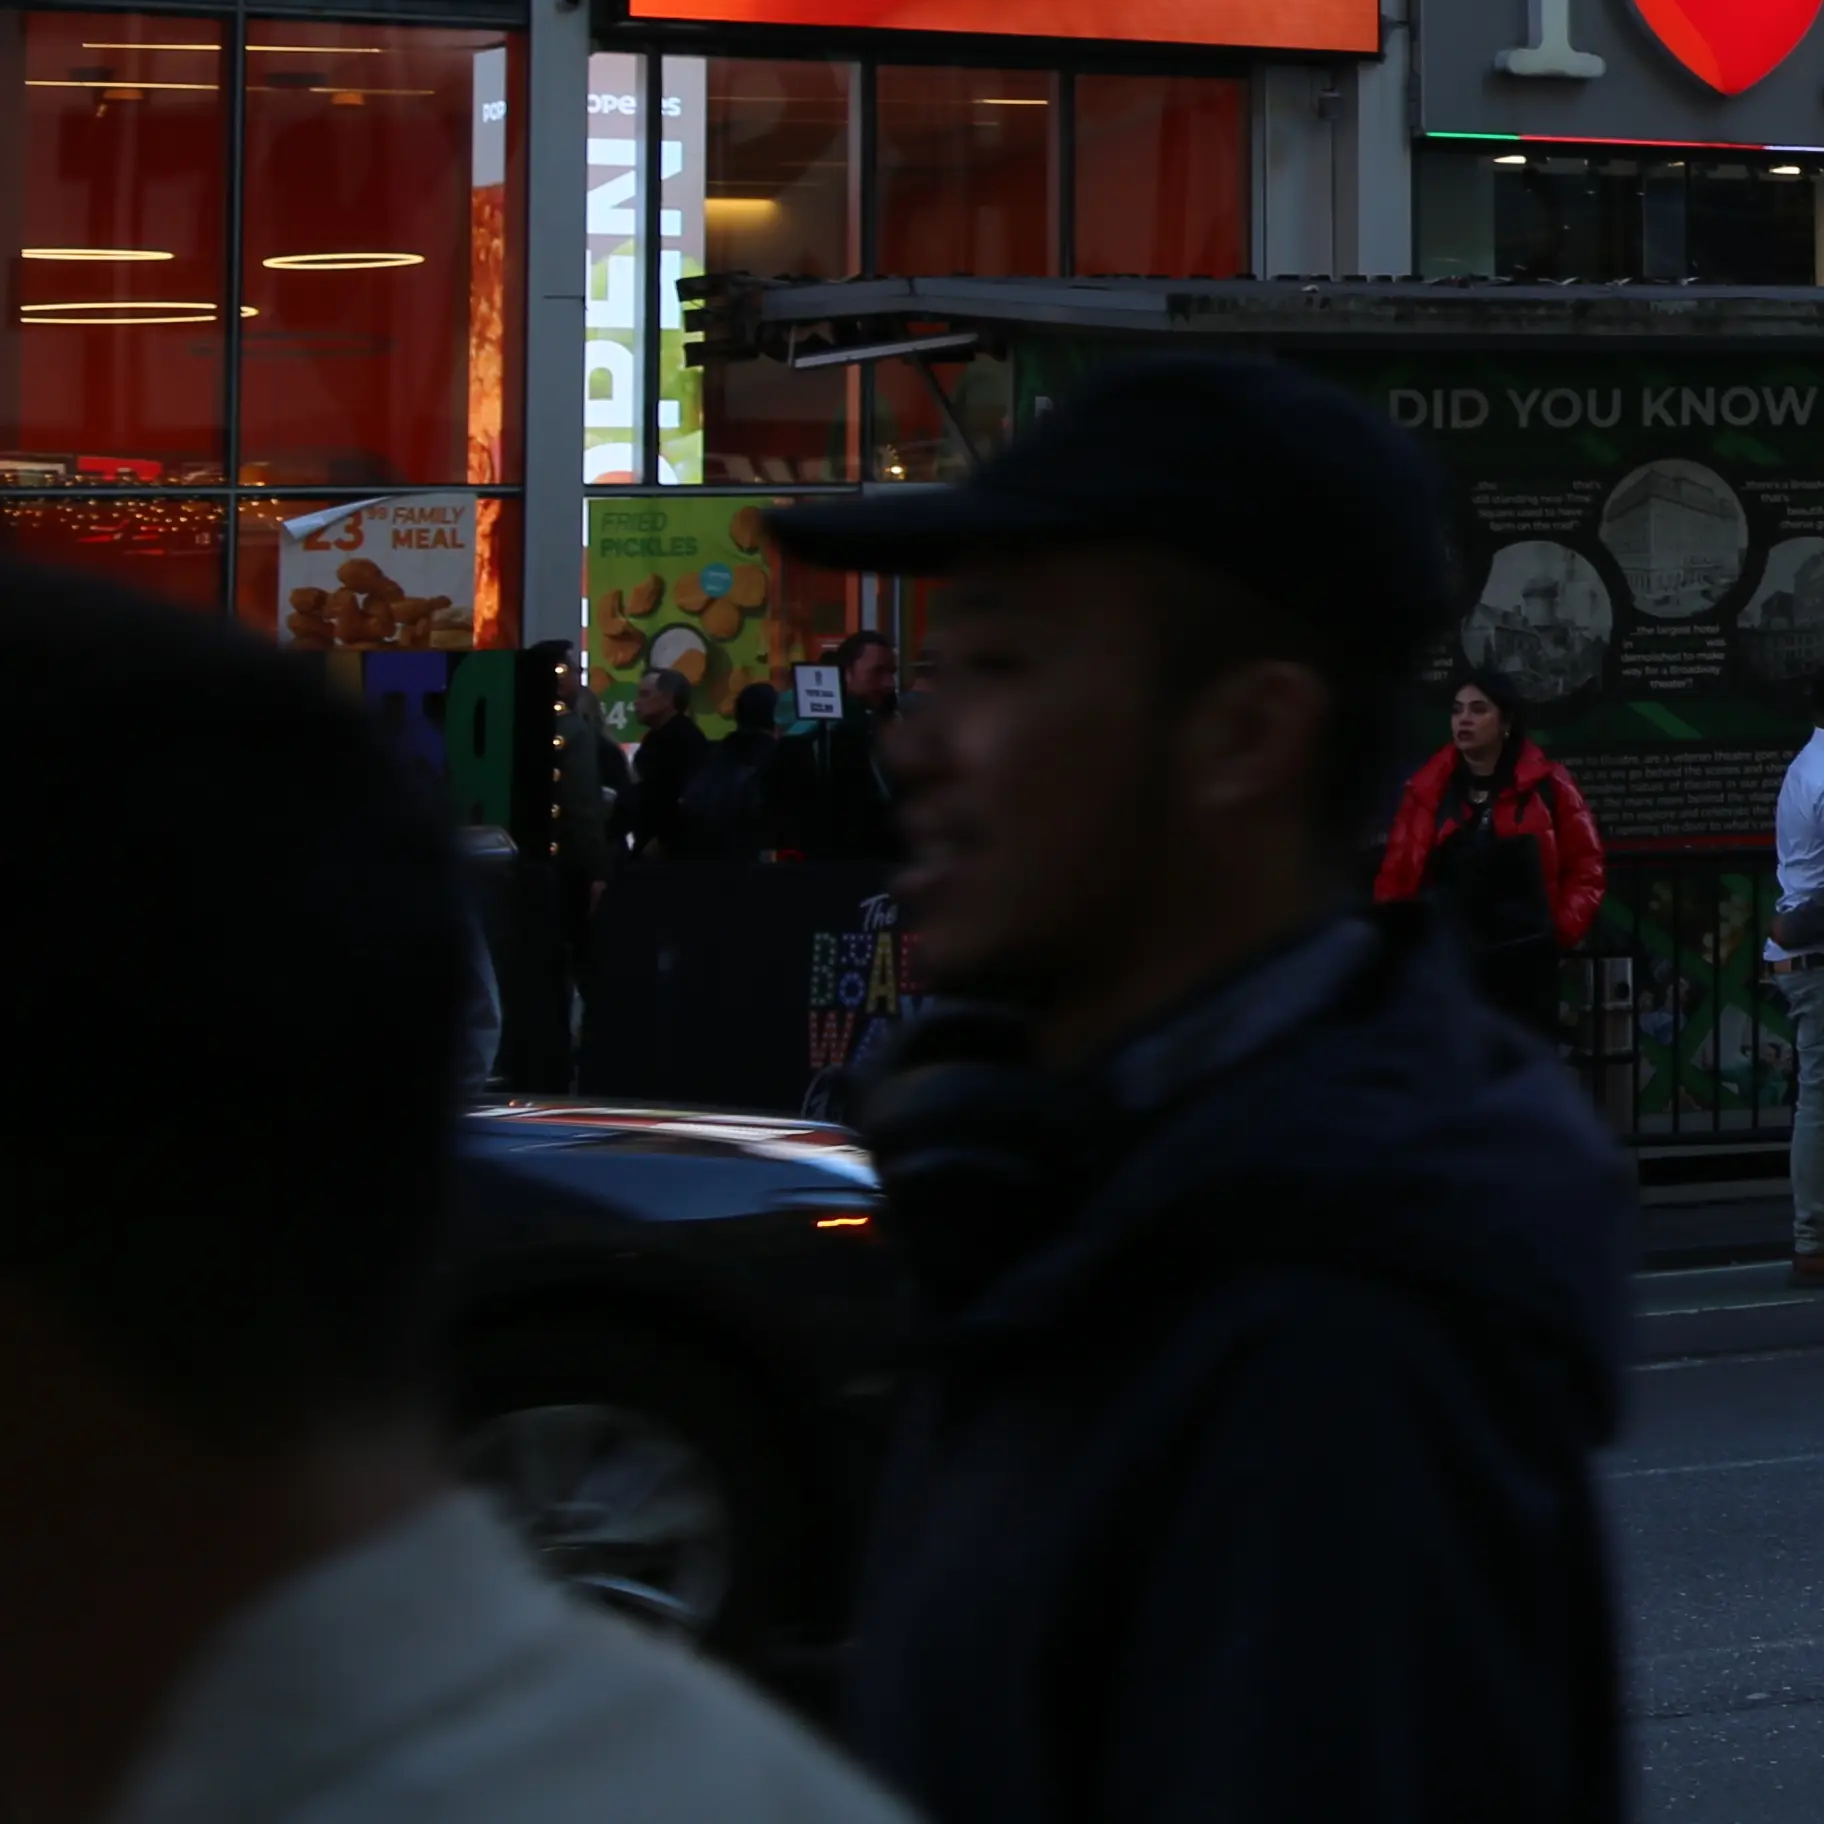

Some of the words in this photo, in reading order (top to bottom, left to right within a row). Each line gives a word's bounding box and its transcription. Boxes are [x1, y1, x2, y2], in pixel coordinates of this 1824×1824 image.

[1389, 387, 1489, 429] DID
[1506, 387, 1622, 428] YOU
[1641, 385, 1819, 426] KNOW
[392, 506, 465, 525] FAMILY
[601, 511, 668, 533] FRIED
[391, 528, 466, 550] MEAL
[600, 536, 698, 558] PICKLES
